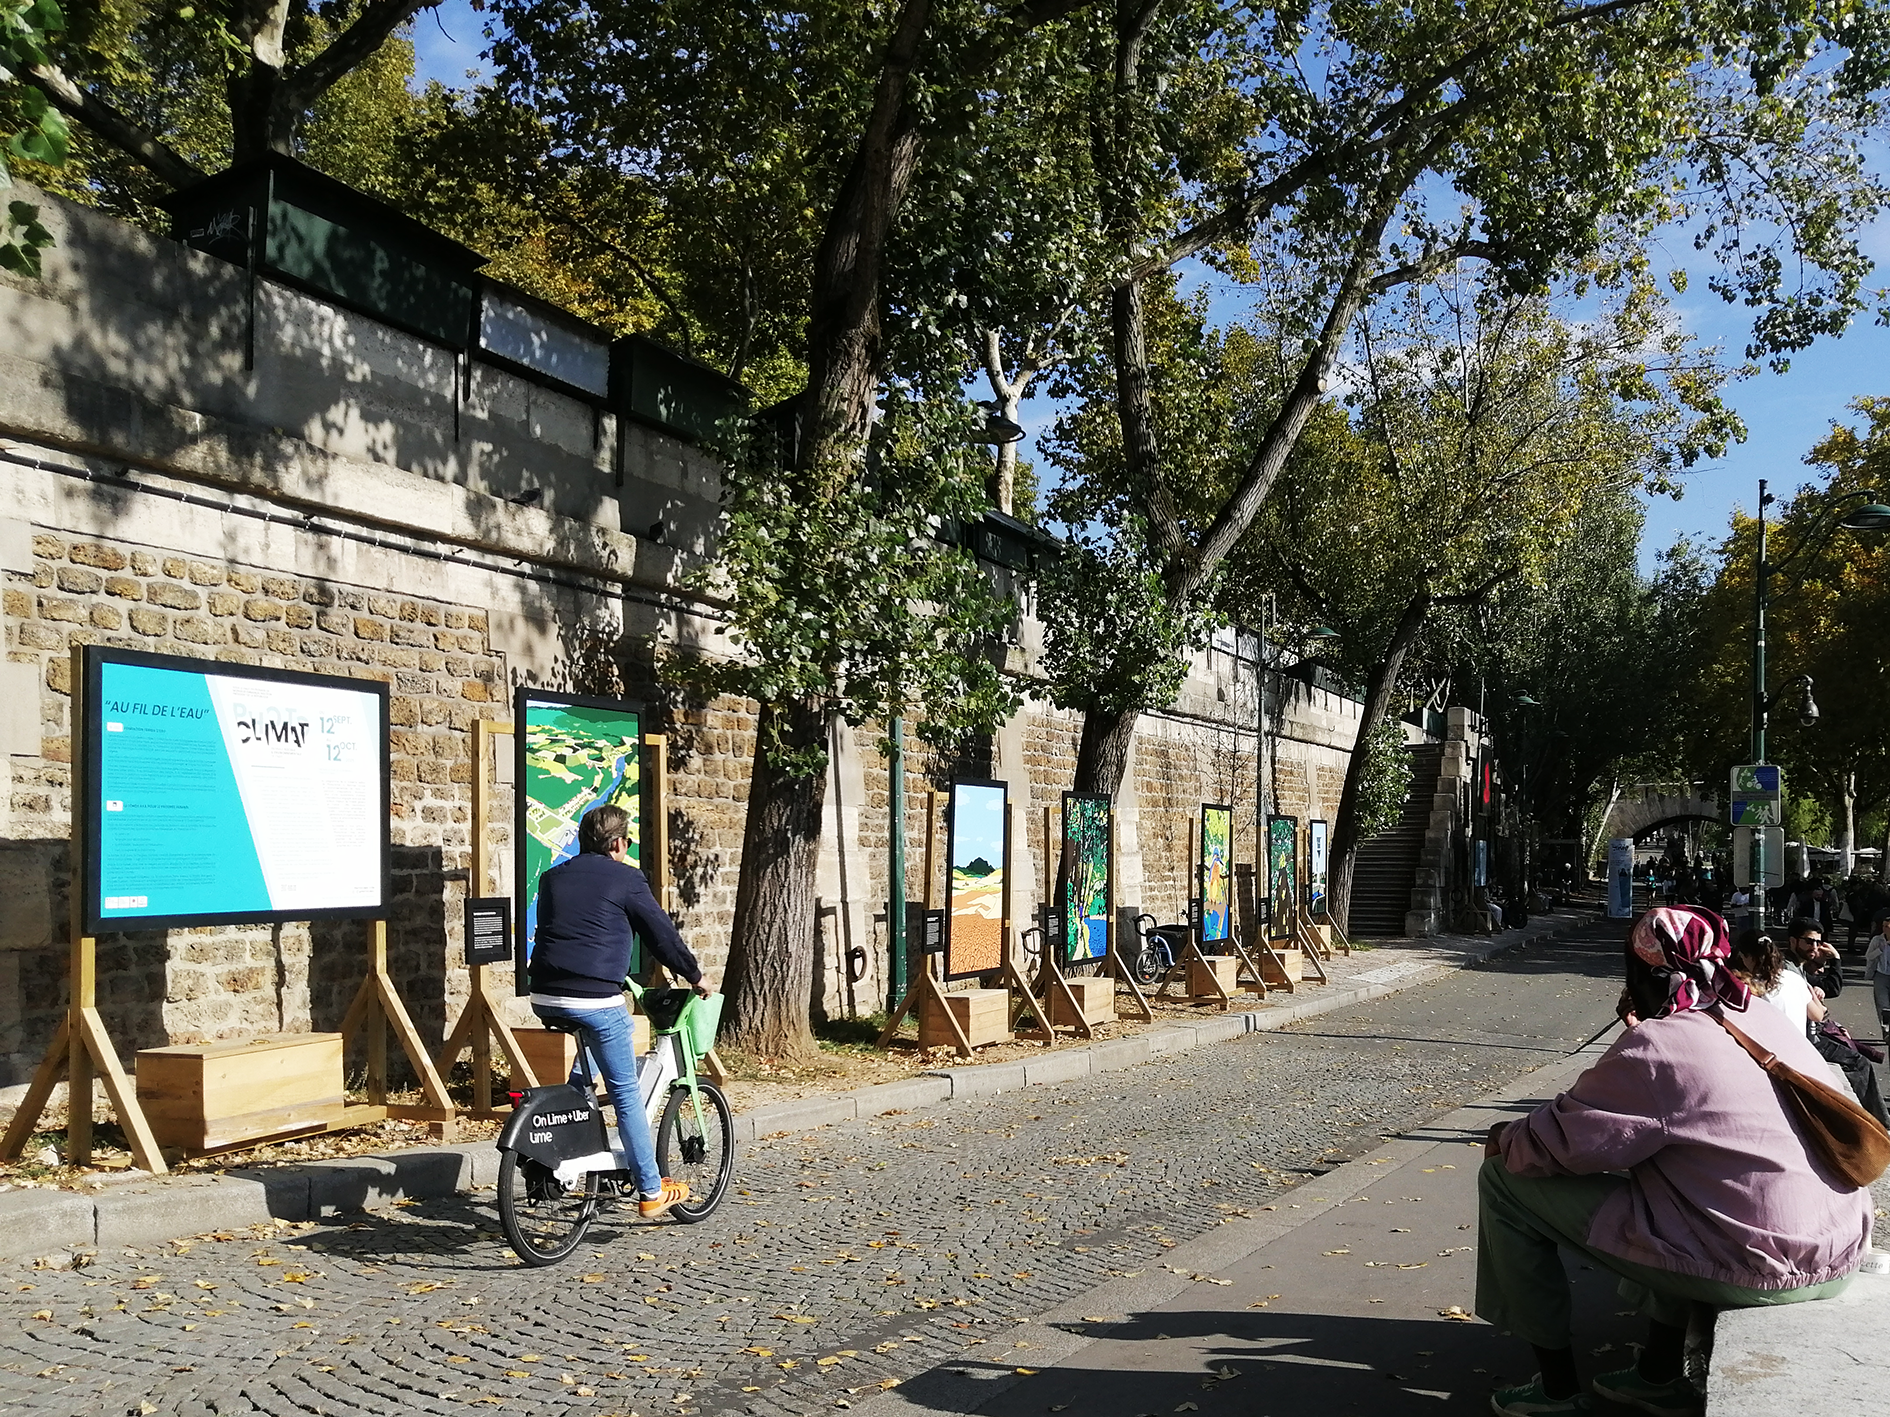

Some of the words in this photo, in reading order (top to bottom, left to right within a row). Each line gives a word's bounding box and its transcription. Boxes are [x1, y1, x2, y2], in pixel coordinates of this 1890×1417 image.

[132, 703, 148, 715] FIL
[152, 705, 168, 717] DE
[237, 718, 309, 748] CLIMAT
[319, 716, 335, 735] 12
[333, 715, 352, 725] SEPT.
[326, 744, 342, 762] 12
[339, 742, 357, 751] OCT.
[533, 1115, 546, 1127] On
[547, 1113, 567, 1125] Lime
[573, 1110, 589, 1121] Uber
[529, 1132, 552, 1143] Lime
